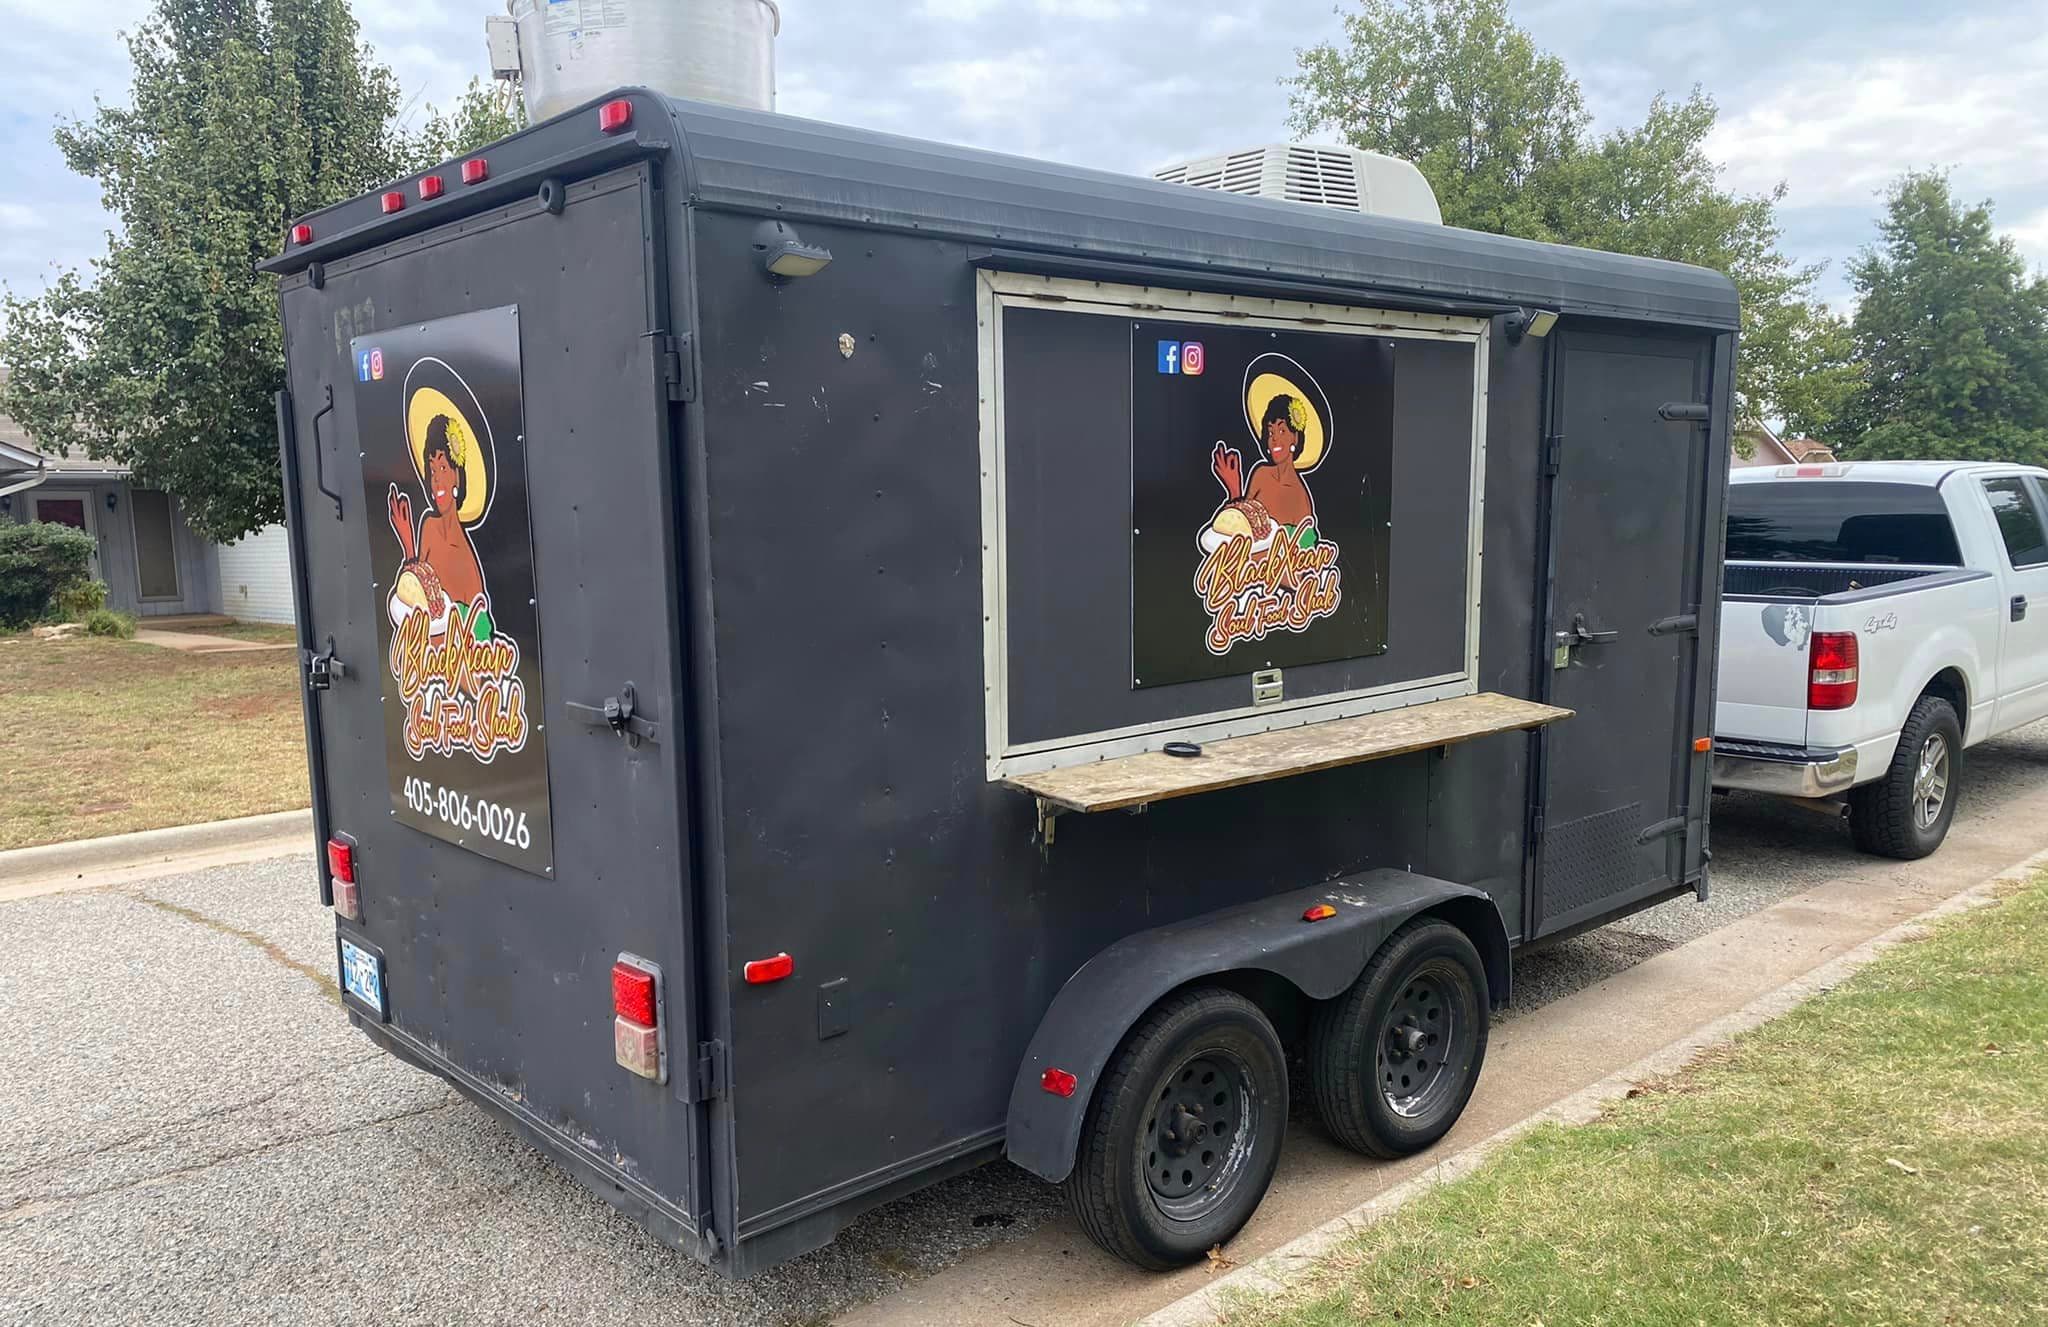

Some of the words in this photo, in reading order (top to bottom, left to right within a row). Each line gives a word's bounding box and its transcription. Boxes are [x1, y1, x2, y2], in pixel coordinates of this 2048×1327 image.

[1209, 596, 1256, 648] Soul
[1257, 594, 1290, 632] Food
[1288, 571, 1338, 626] Shak
[407, 692, 441, 751] Soul
[441, 700, 472, 748] Food
[471, 685, 523, 753] Shak
[403, 775, 530, 850] 405-806-0026
